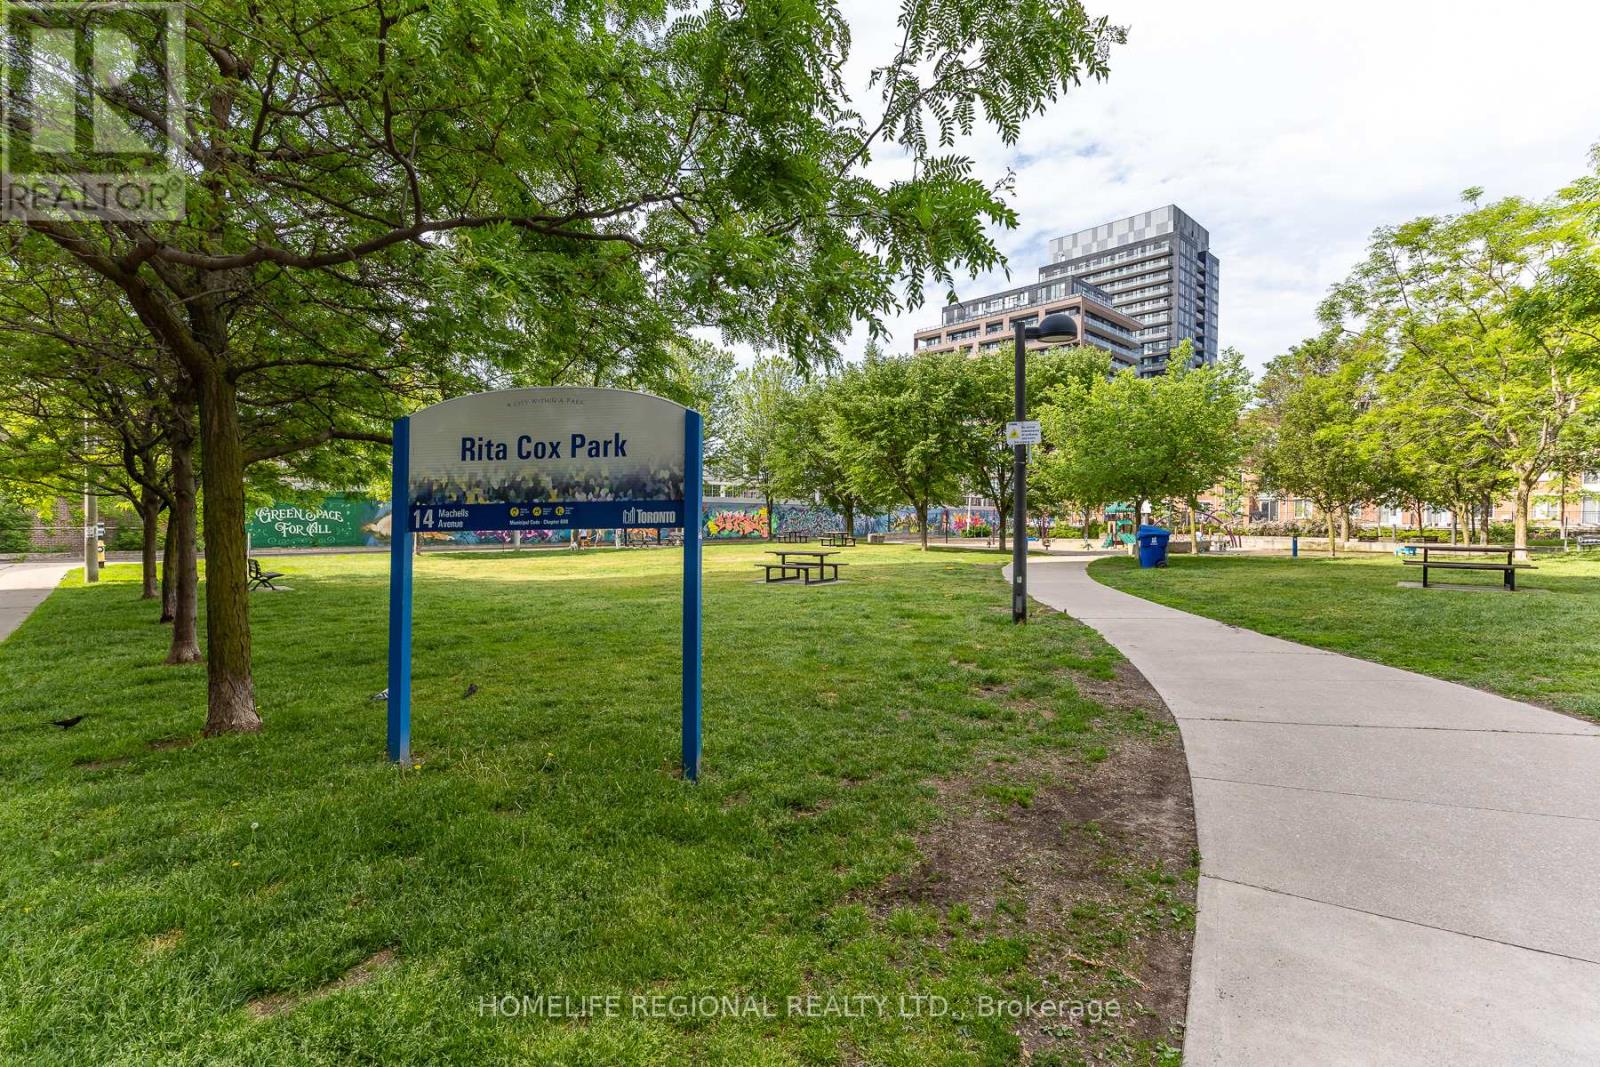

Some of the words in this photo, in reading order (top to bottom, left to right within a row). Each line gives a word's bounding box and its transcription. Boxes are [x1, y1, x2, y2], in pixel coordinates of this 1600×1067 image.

[461, 437, 508, 462] Rita
[517, 435, 561, 460] Cox
[571, 432, 628, 458] Park
[255, 506, 306, 523] GREEN
[413, 509, 434, 529] 14
[438, 508, 469, 518] Machells
[636, 509, 676, 524] TORONTO
[274, 521, 308, 538] FOR
[306, 521, 332, 537] ALL
[438, 519, 464, 528] Avenue
